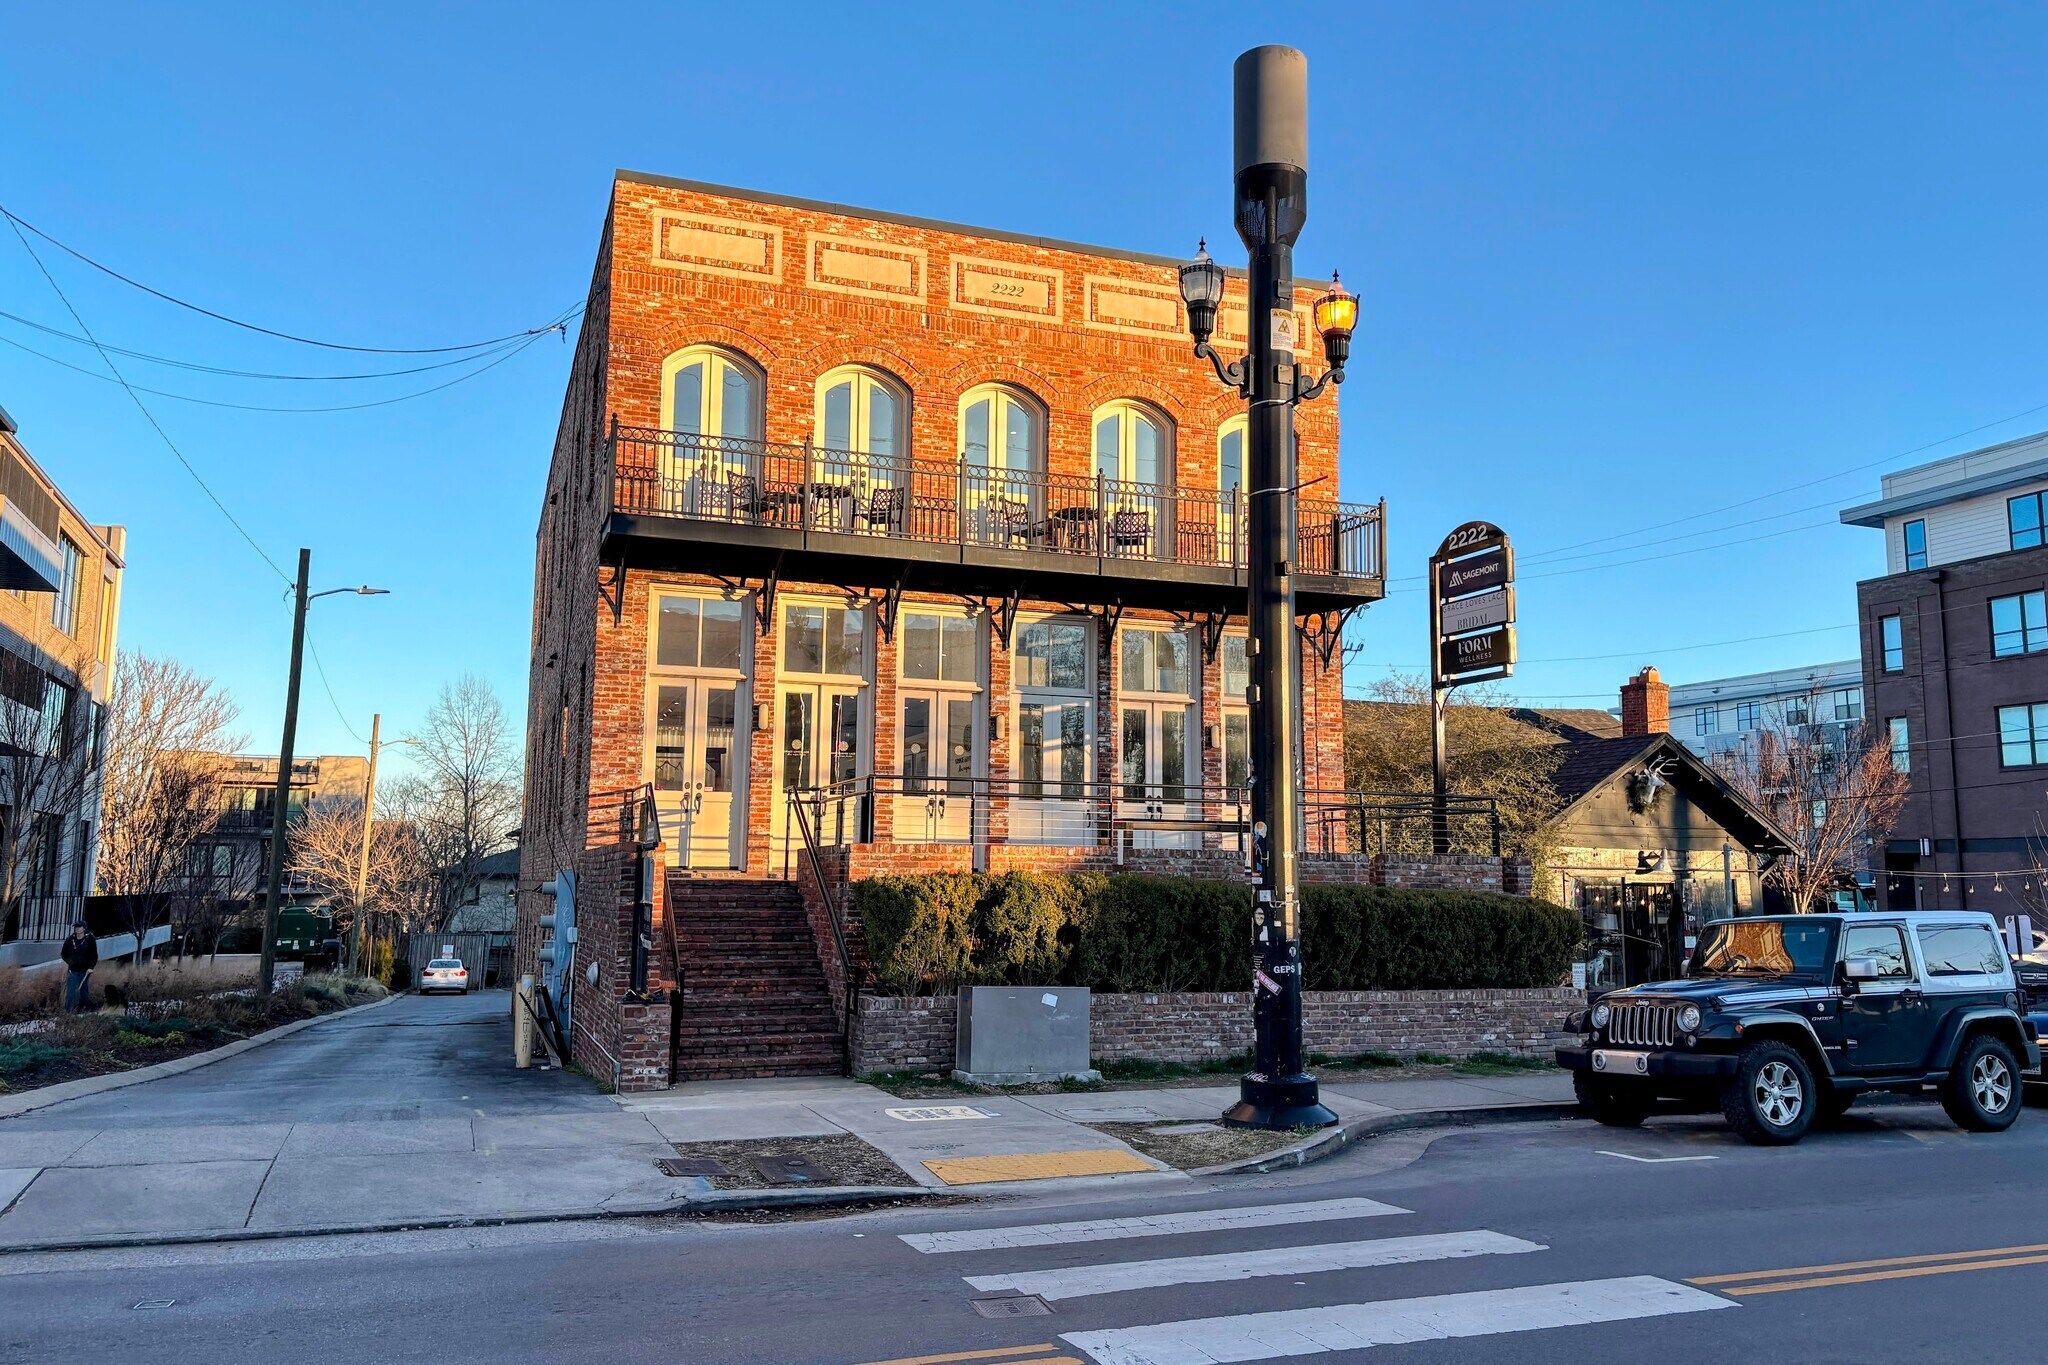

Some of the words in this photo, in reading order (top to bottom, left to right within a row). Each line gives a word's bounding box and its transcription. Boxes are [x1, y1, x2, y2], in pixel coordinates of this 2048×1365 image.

[991, 282, 1025, 297] 2222
[1448, 524, 1488, 551] 2222
[1462, 562, 1499, 580] SAGEMONT
[1443, 603, 1464, 614] GRACE
[1465, 596, 1486, 608] LOVES
[1488, 591, 1505, 602] LACE
[1457, 613, 1491, 630] BRIDAL
[1458, 635, 1492, 655] FORM
[1459, 651, 1492, 664] WELLNESS
[1273, 964, 1296, 974] GEPS
